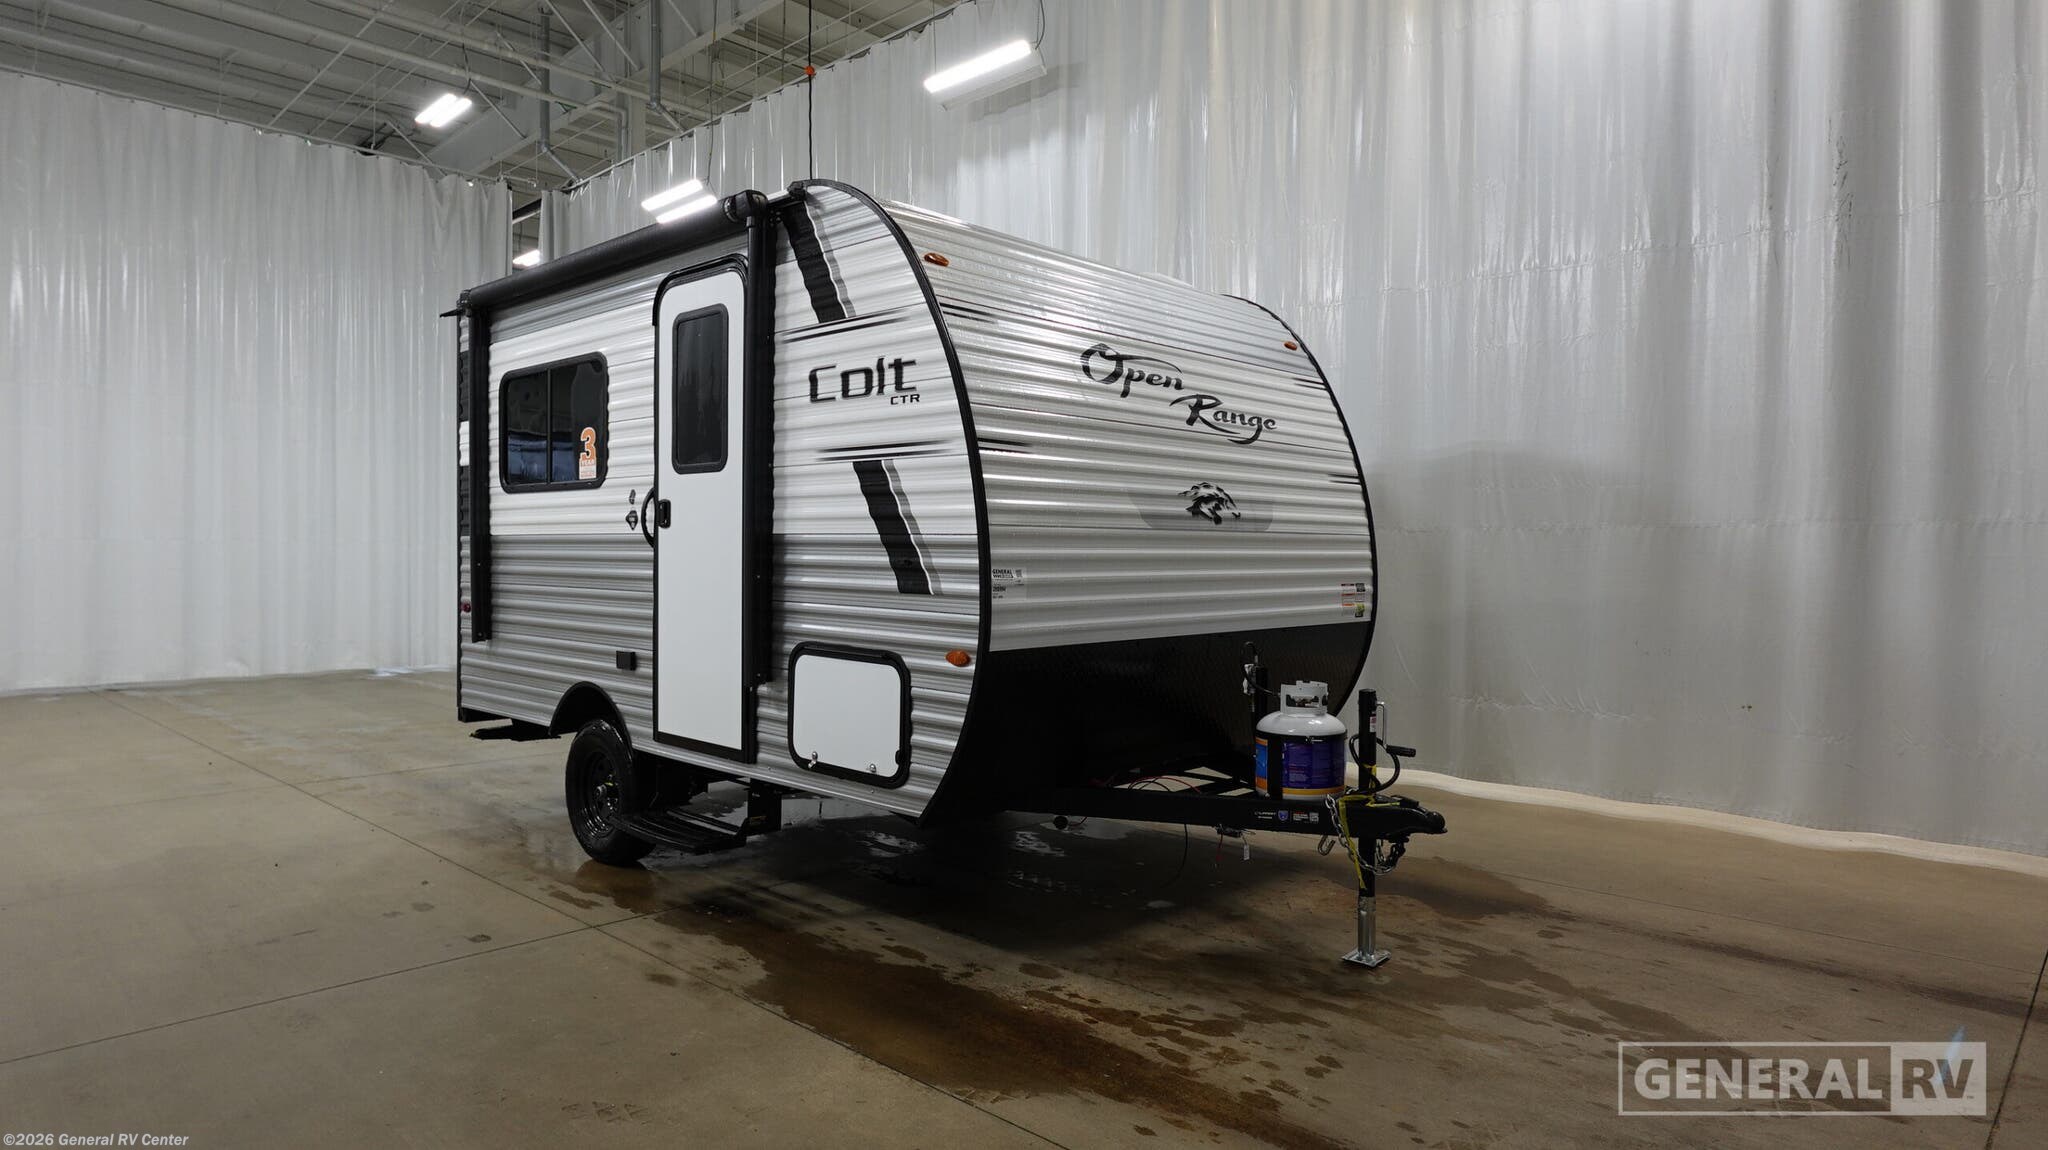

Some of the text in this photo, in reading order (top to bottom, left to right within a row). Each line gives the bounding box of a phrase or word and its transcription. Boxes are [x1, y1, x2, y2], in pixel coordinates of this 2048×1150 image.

[809, 356, 917, 402] Colt
[1080, 343, 1184, 398] Open
[890, 394, 920, 405] CTR
[1169, 394, 1277, 444] Range
[580, 427, 596, 460] 3
